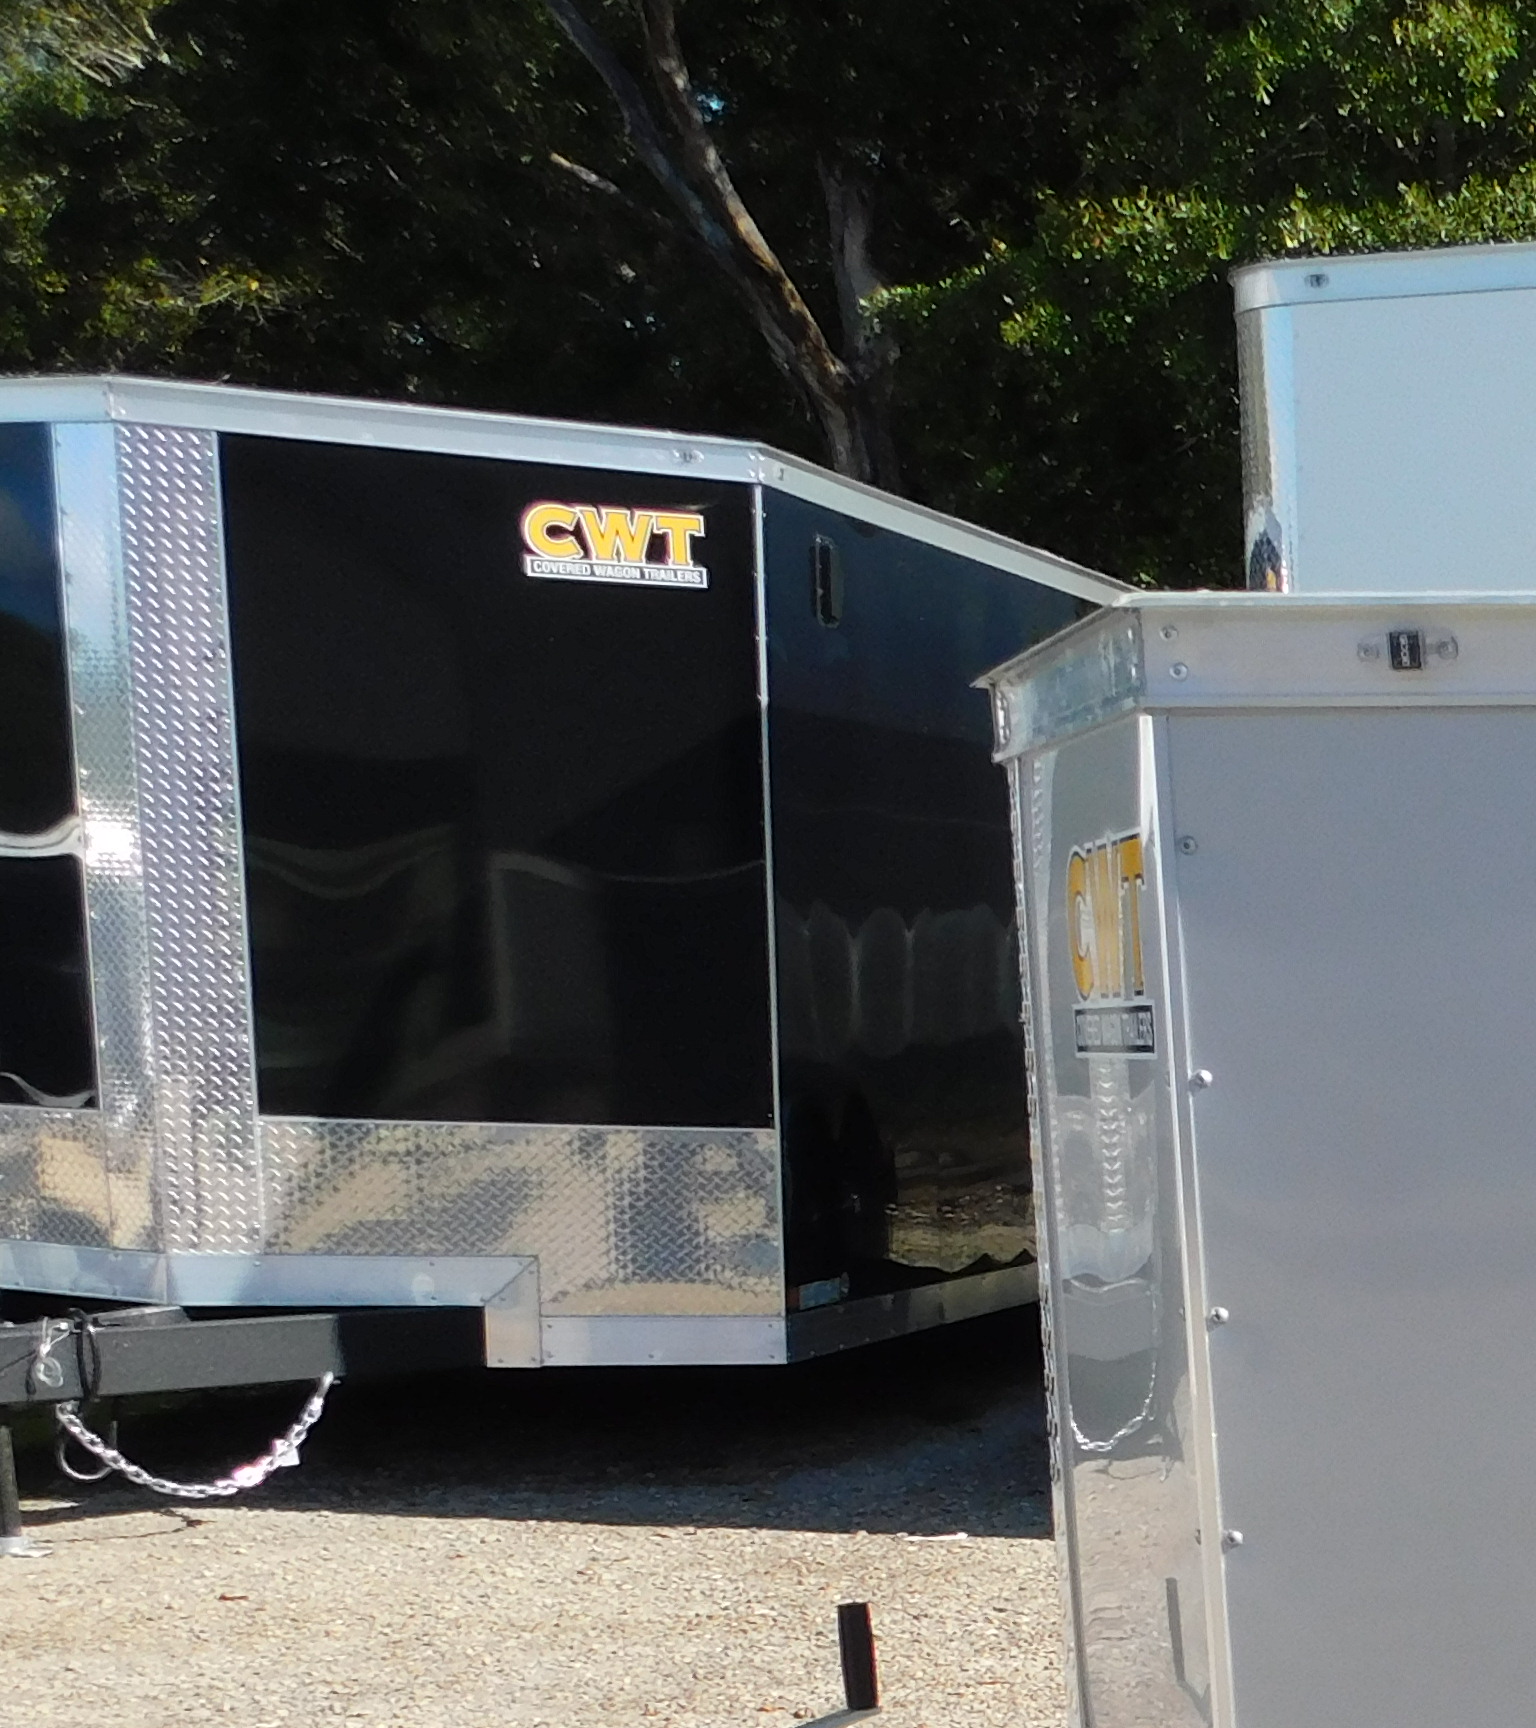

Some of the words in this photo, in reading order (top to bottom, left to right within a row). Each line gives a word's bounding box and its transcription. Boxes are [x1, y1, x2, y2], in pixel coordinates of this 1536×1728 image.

[524, 502, 706, 566] CWT
[533, 560, 591, 577] COVERED
[593, 563, 641, 579] WAGON
[643, 567, 702, 584] TRAILERS
[1066, 832, 1146, 1000] CWT
